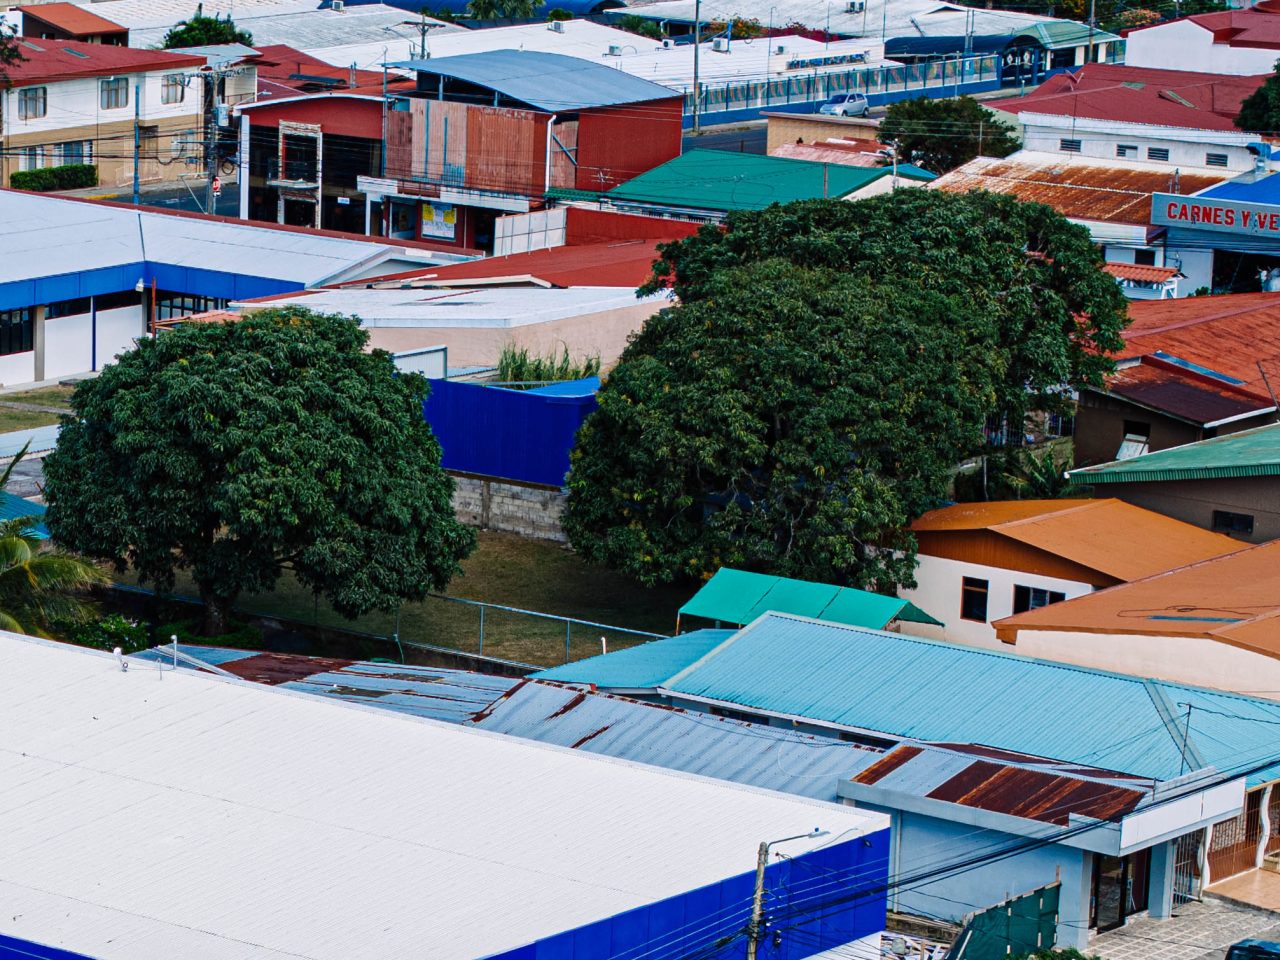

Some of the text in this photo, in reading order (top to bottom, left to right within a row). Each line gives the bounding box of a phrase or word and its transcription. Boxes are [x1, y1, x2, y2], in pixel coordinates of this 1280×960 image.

[1167, 202, 1280, 231] CARNES Y VE
